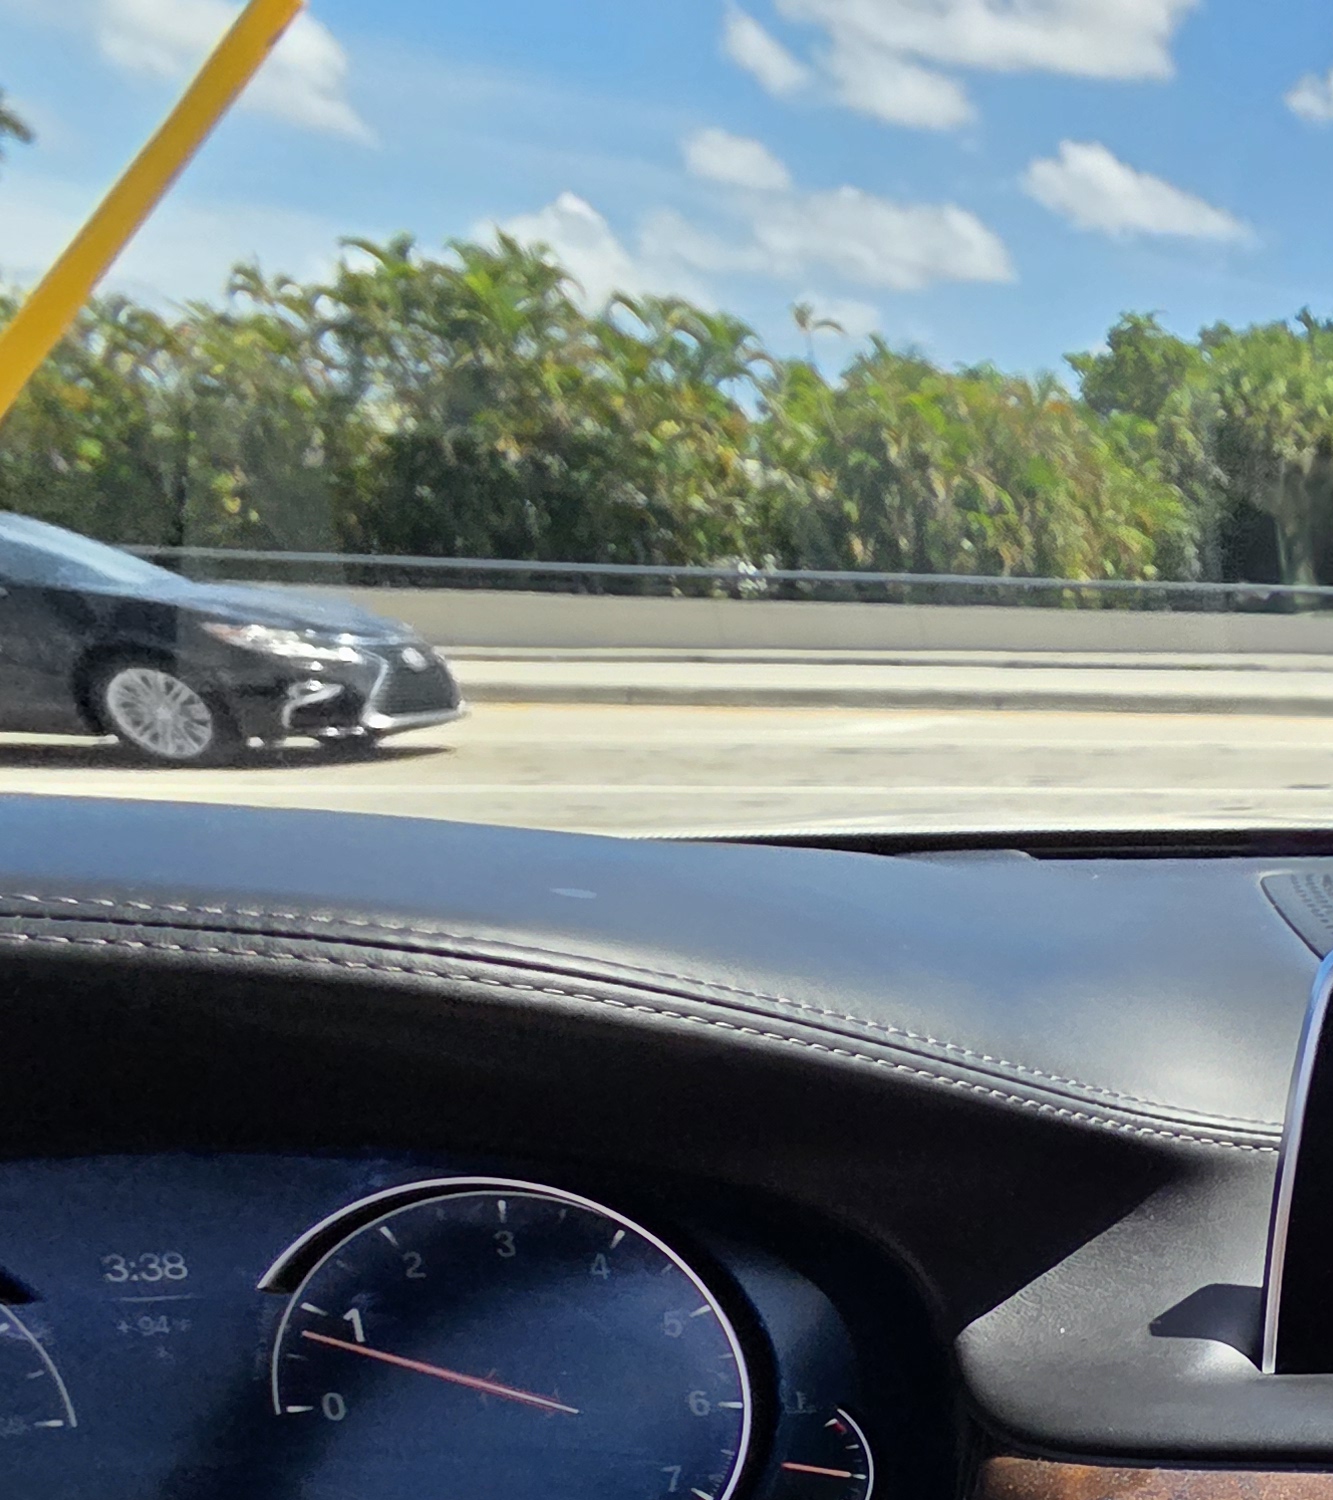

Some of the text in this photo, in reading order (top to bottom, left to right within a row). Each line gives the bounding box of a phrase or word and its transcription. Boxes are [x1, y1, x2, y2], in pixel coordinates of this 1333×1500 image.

[492, 1230, 517, 1258] 3
[102, 1251, 189, 1283] 3:38
[402, 1251, 427, 1279] 2
[589, 1252, 612, 1280] 4
[343, 1307, 367, 1343] 1
[661, 1310, 684, 1339] 5
[321, 1391, 347, 1422] 0
[687, 1389, 712, 1418] 6
[659, 1464, 682, 1493] 7
